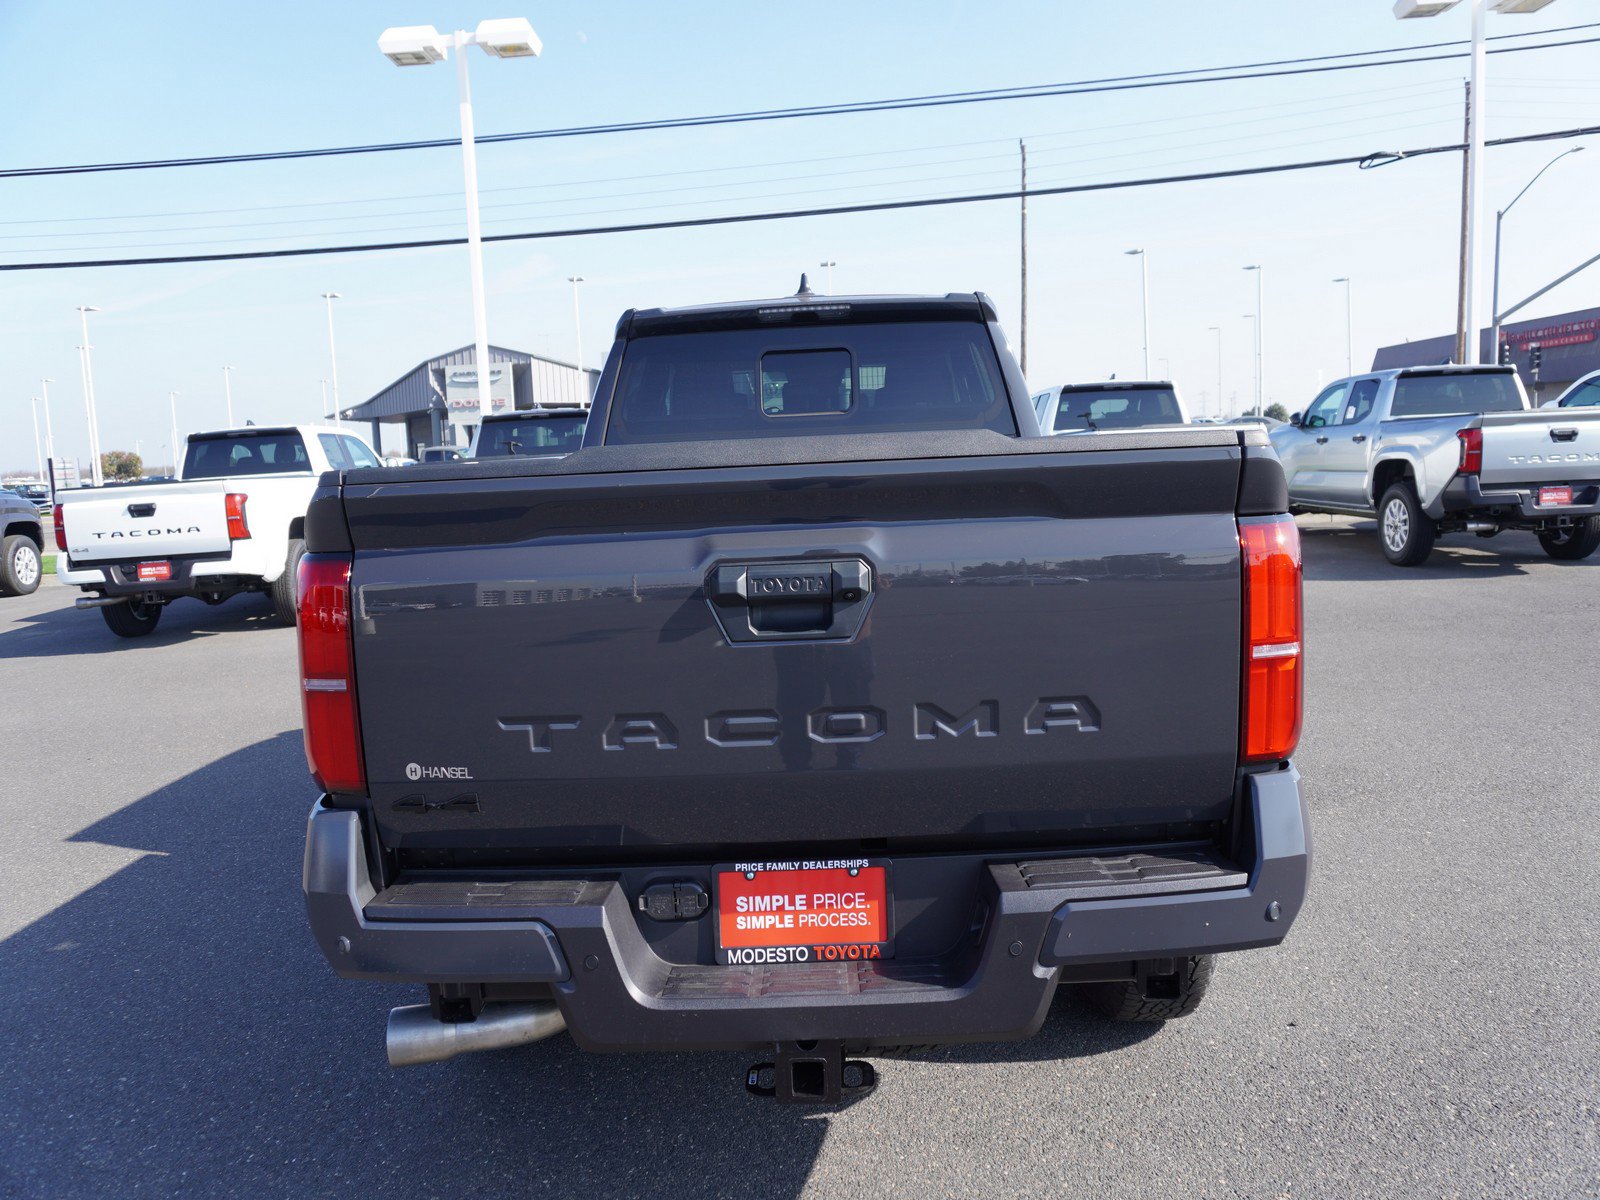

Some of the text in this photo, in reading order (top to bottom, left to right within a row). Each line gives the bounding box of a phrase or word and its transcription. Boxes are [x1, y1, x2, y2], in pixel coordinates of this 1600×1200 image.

[92, 526, 201, 539] TACOMA
[751, 576, 828, 594] TOYOTA
[497, 694, 1103, 753] TACOMA
[422, 766, 473, 779] HANSEL
[735, 859, 869, 872] PRICE FAMILY DEALERSHIPS
[735, 892, 871, 913] SIMPLE PRICE.
[736, 912, 872, 930] SIMPLE PROCESS.
[727, 944, 882, 964] MODESTO TOYOTA
